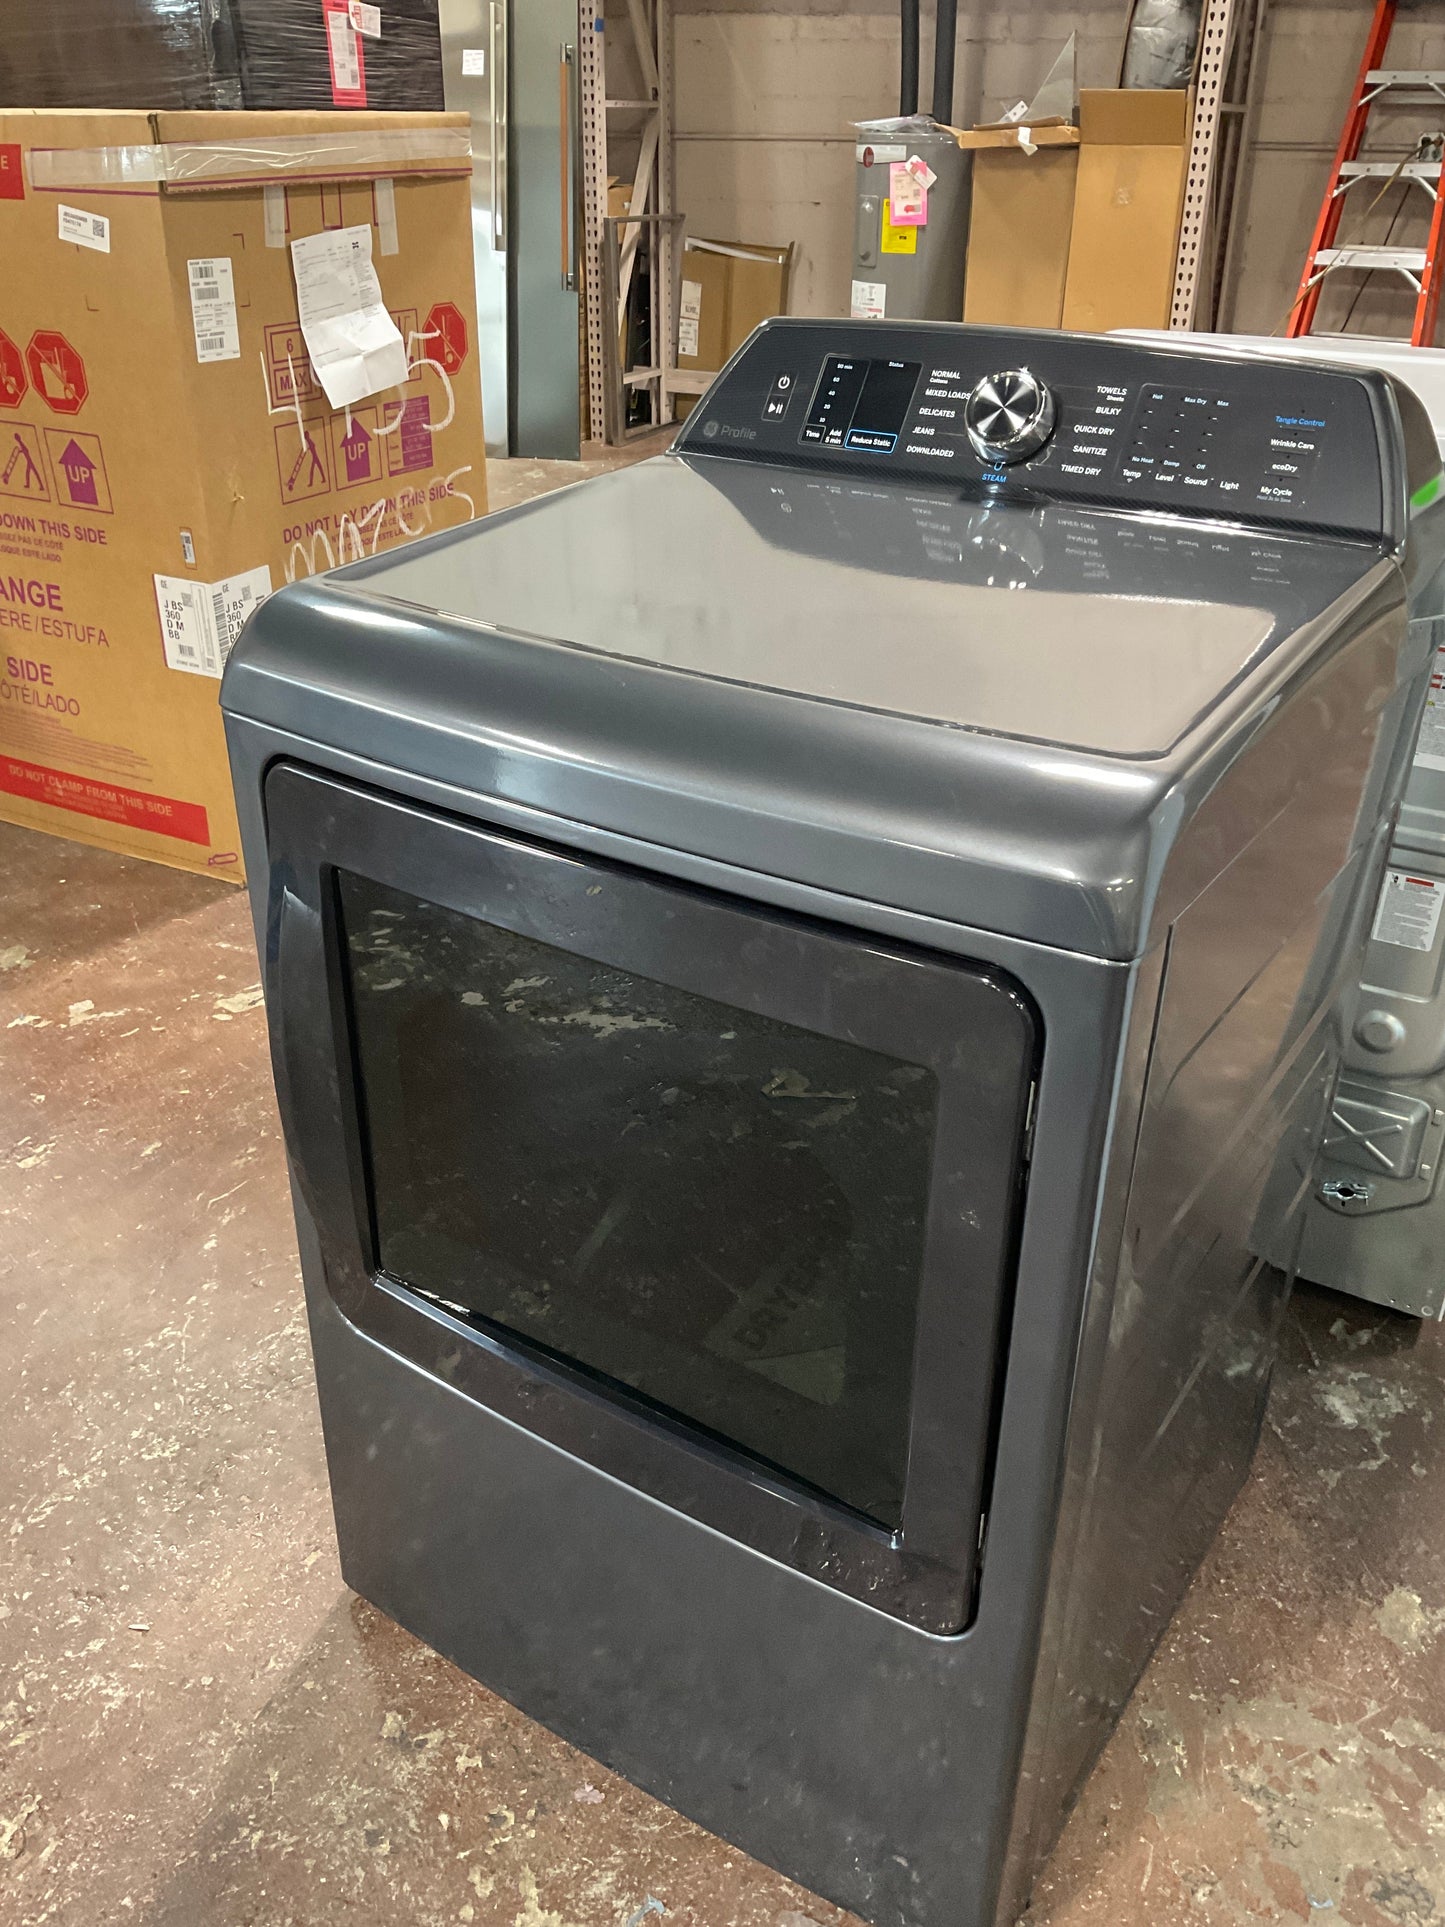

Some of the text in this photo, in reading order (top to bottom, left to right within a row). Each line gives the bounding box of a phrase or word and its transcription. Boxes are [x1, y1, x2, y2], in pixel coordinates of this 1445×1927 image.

[286, 338, 294, 353] 6
[931, 370, 961, 380] NORMAL
[280, 372, 308, 392] MAX
[925, 388, 971, 400] MIXED LOADS
[1096, 386, 1128, 396] TOWELS
[1106, 394, 1125, 402] Sheets
[1152, 393, 1164, 401] Hot
[1184, 396, 1207, 406] Max Dry
[1216, 399, 1230, 407] Max
[919, 407, 955, 418] DELICATES
[1095, 406, 1121, 416] BULKY
[1275, 415, 1326, 428] Tangle Control
[720, 425, 757, 440] Profile
[805, 429, 821, 439] Time
[829, 429, 842, 437] Add
[912, 426, 935, 436] JEANS
[1073, 424, 1115, 436] QUICK DRY
[825, 436, 842, 446] 5 min
[851, 435, 891, 448] Reduce Static
[1270, 438, 1315, 450] Wrinkle Care
[349, 443, 366, 461] UP
[906, 445, 955, 458] DOWNLOADED
[1072, 445, 1107, 456] SANITIZE
[1163, 459, 1180, 468] Damp
[1271, 463, 1298, 473] ecoDry
[68, 464, 91, 484] UP
[1060, 464, 1102, 476] TIMED DRY
[1122, 469, 1142, 479] Temp
[981, 473, 1007, 483] STEAM
[1155, 473, 1175, 482] Level
[1183, 476, 1208, 487] Sound
[1219, 480, 1240, 491] Light
[1260, 486, 1293, 497] My Cycle
[283, 528, 302, 544] DO
[305, 516, 330, 537] NOT
[399, 491, 426, 506] THIS
[429, 483, 454, 501] SIDE
[38, 518, 71, 539] THIS
[74, 525, 107, 545] SIDE
[160, 580, 167, 589] GE
[222, 584, 229, 593] GE
[171, 601, 184, 612] BS
[233, 599, 244, 610] BS
[165, 610, 181, 621] 360
[227, 611, 242, 624] 360
[169, 629, 181, 640] BB
[7, 656, 54, 686] SIDE
[9, 764, 23, 777] DO
[25, 770, 45, 783] NOT
[49, 776, 83, 794] CLAMP
[86, 786, 117, 803] FROM
[119, 794, 144, 810] THIS
[148, 802, 173, 817] SIDE
